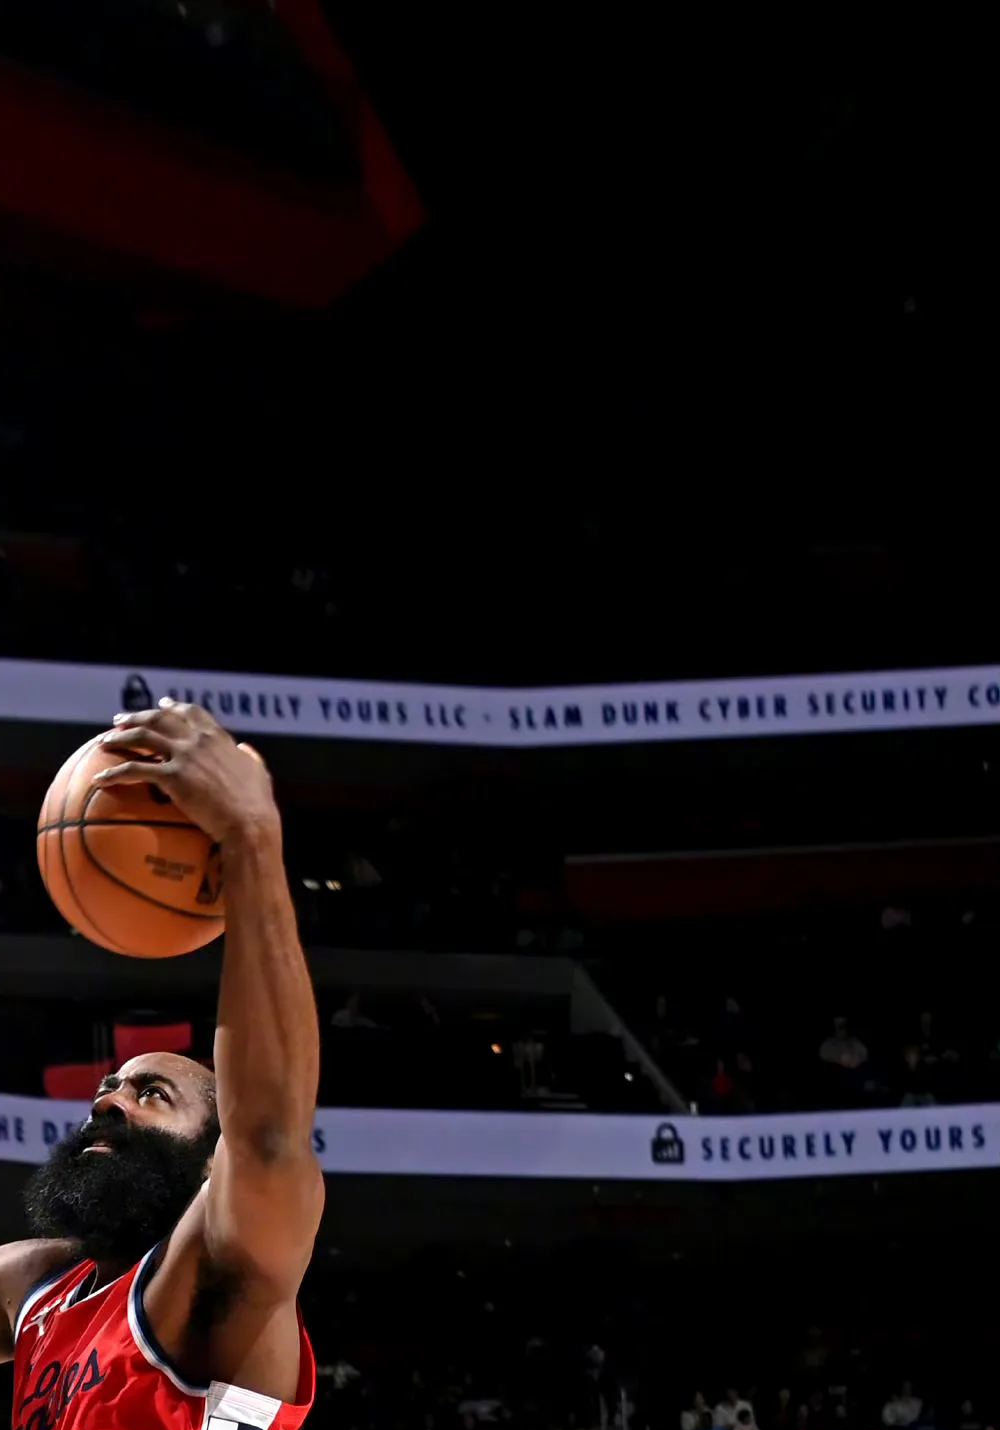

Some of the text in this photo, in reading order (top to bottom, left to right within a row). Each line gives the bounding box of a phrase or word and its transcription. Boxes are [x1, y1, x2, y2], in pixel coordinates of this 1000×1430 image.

[316, 695, 408, 726] YOURS
[424, 702, 467, 729] LLC
[508, 704, 583, 730] SLAM
[602, 699, 681, 727] DUNK
[698, 693, 788, 722] CYBER
[807, 685, 949, 717] SECURITY
[701, 1124, 987, 1161] SECURELY YOURS
